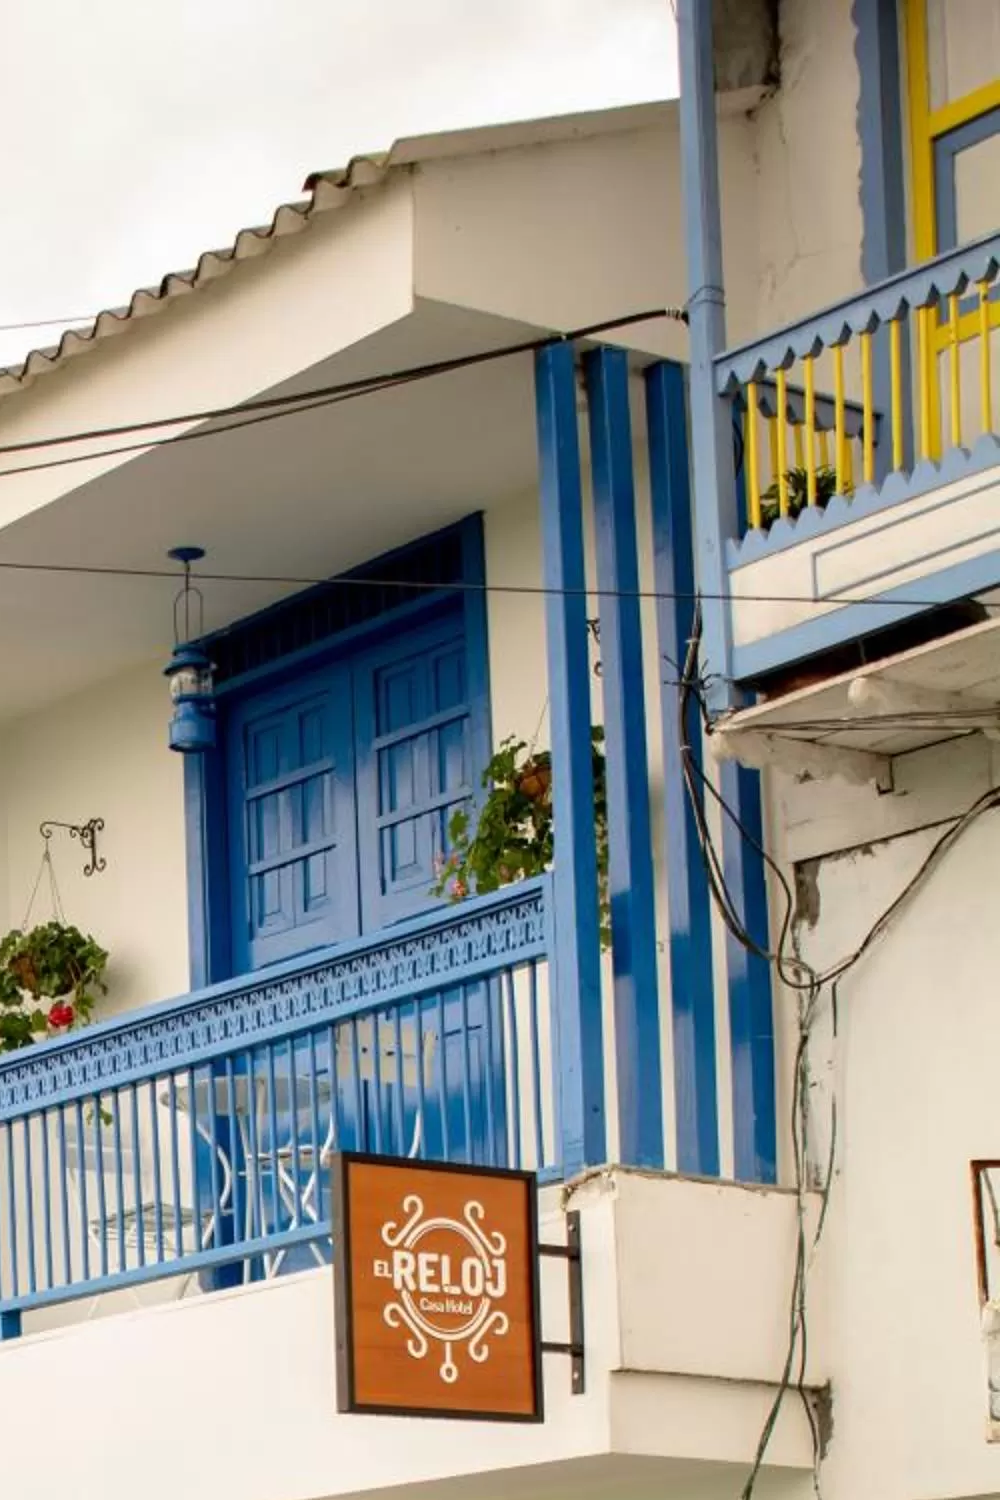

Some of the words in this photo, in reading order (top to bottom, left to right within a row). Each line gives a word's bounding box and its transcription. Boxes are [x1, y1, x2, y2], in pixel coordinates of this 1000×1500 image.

[373, 1259, 393, 1278] EL
[392, 1249, 507, 1298] RELOJ
[419, 1297, 444, 1313] Casa
[445, 1298, 473, 1315] Hotel
